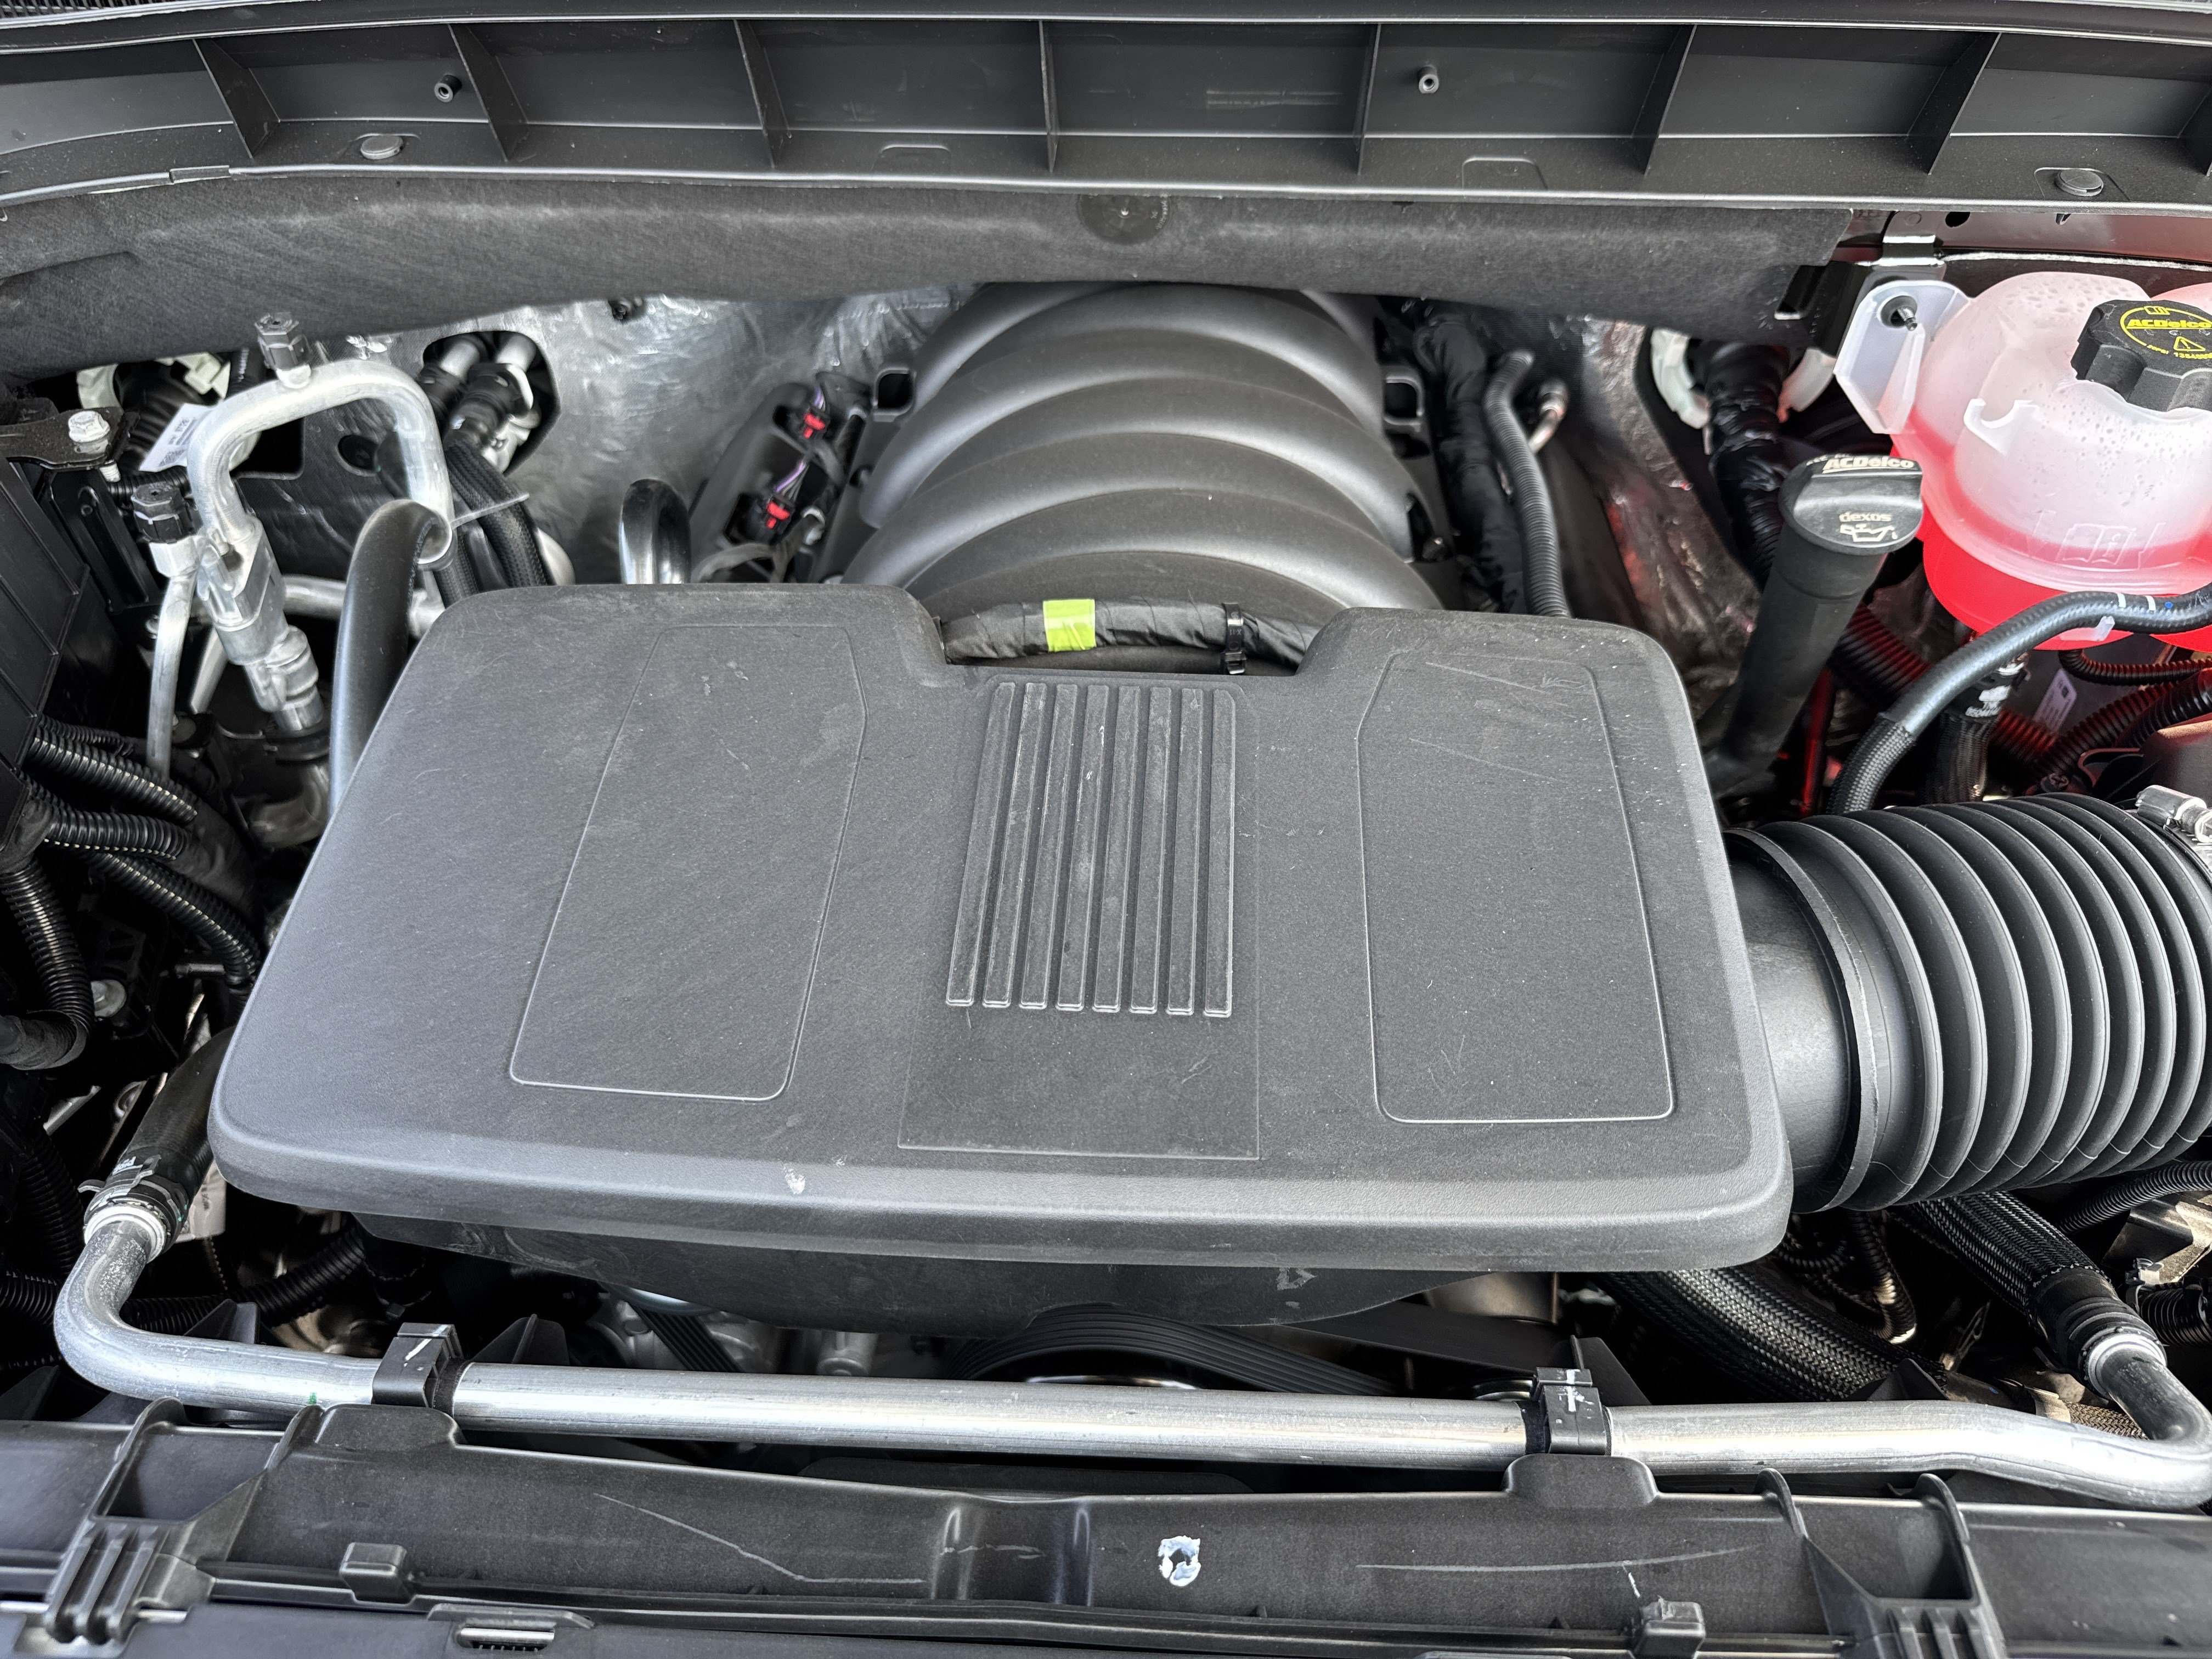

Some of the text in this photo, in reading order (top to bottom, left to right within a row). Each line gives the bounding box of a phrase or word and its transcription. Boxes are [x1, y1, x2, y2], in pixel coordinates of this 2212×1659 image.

[2127, 319, 2212, 328] ACDelco
[1822, 456, 1915, 471] ACDelco
[1839, 511, 1893, 522] dexos
